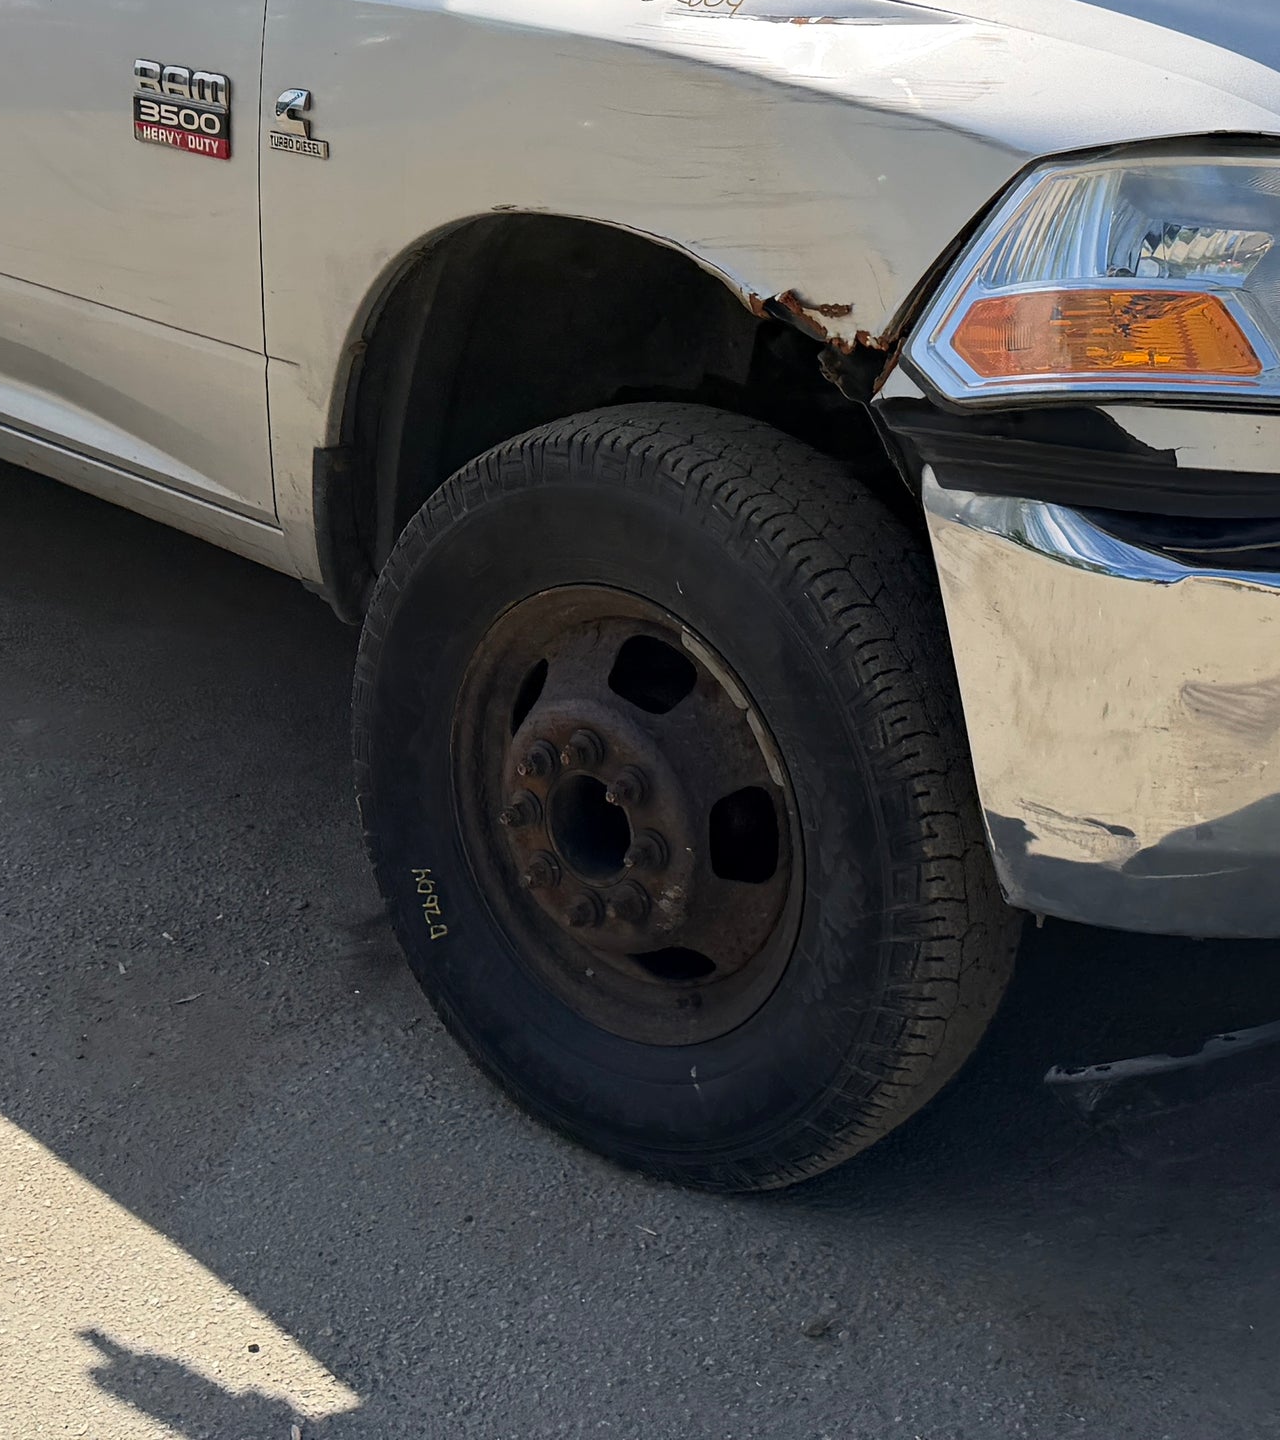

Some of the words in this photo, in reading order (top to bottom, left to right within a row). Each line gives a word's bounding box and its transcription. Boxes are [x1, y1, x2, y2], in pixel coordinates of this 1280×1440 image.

[133, 58, 230, 108] RAM
[139, 99, 221, 135] 3500
[142, 125, 183, 146] HEAVY
[188, 137, 219, 154] DUTY
[269, 134, 295, 150] TURBO
[295, 139, 322, 155] DIESEL
